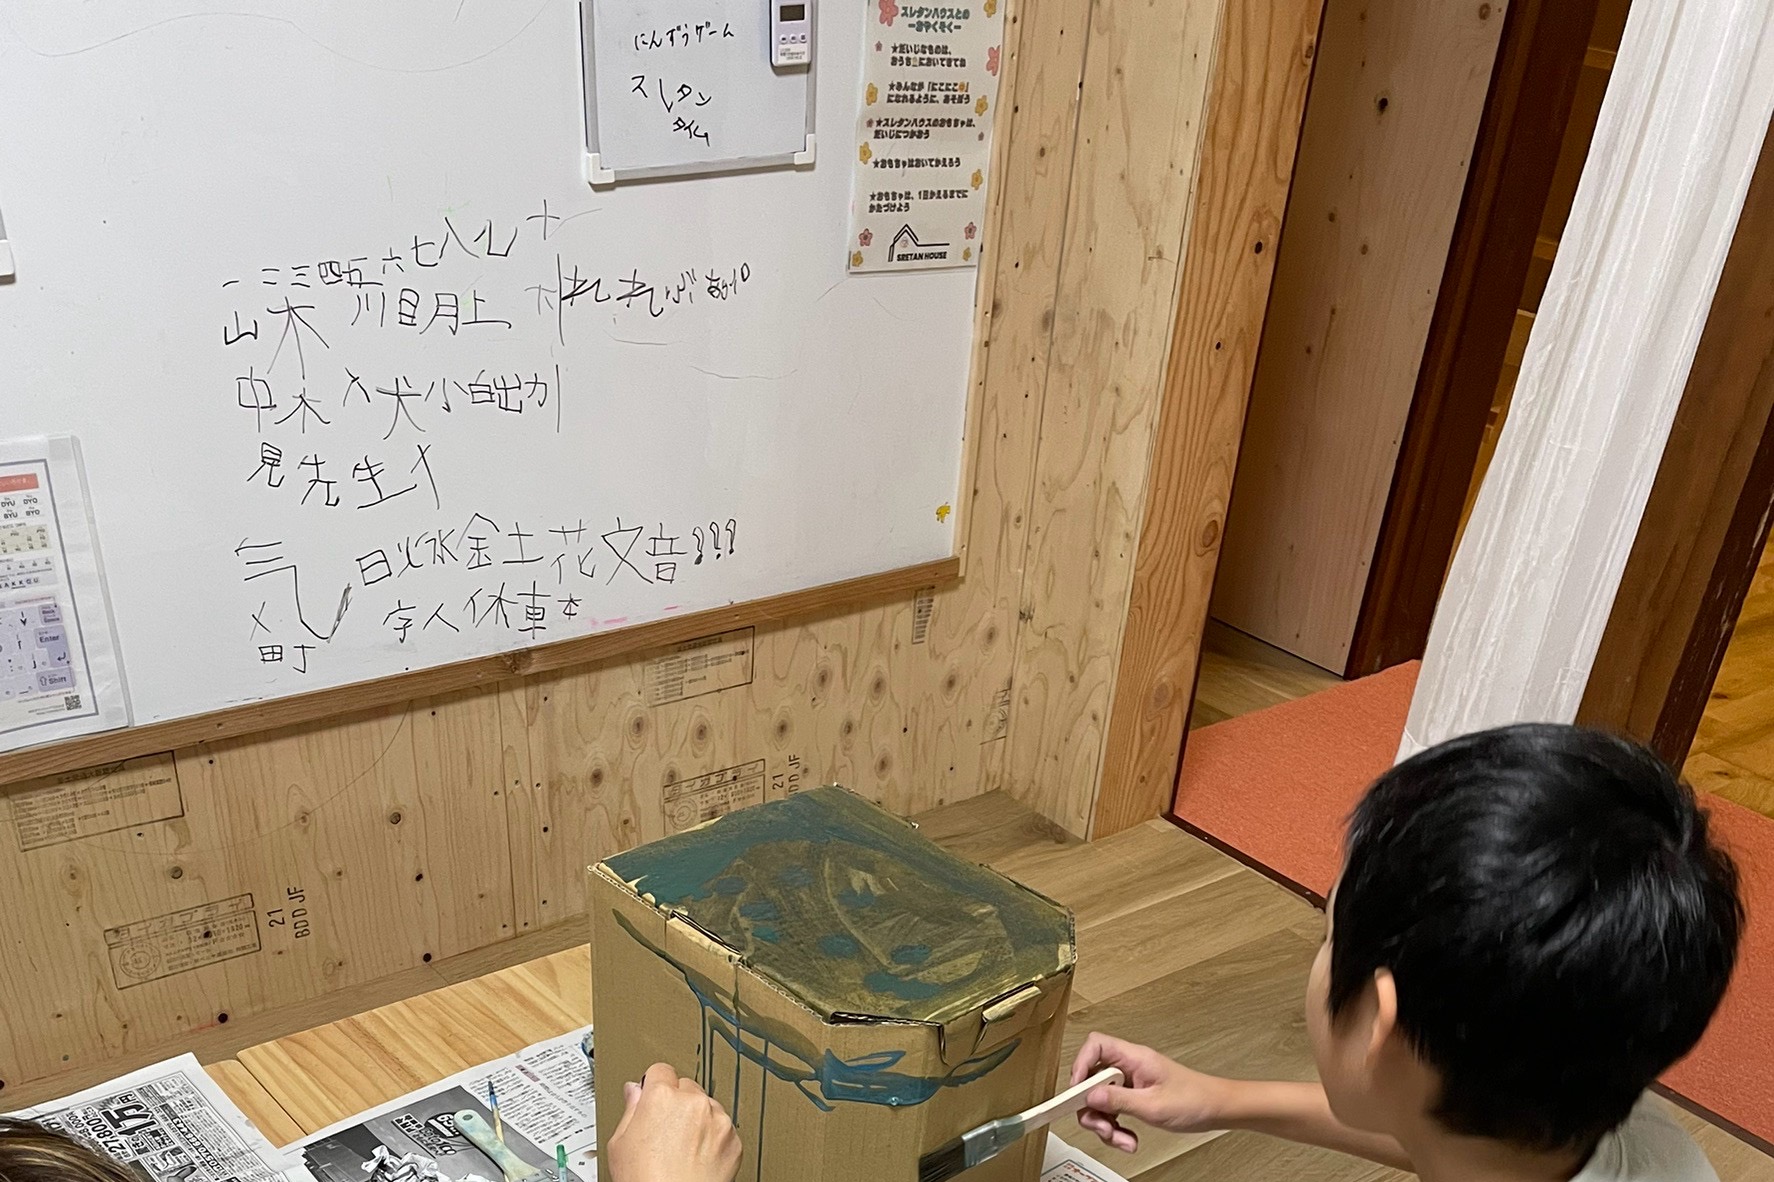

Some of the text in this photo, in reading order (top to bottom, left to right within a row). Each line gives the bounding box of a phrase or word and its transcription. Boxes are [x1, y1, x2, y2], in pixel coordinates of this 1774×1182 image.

[901, 6, 971, 19] スレタンハウスとの
[896, 251, 948, 261] SRETAN HOUSE
[39, 633, 60, 643] Enter
[48, 675, 67, 685] Shift
[772, 772, 785, 790] 21
[287, 886, 305, 904] JF
[268, 908, 287, 928] 21
